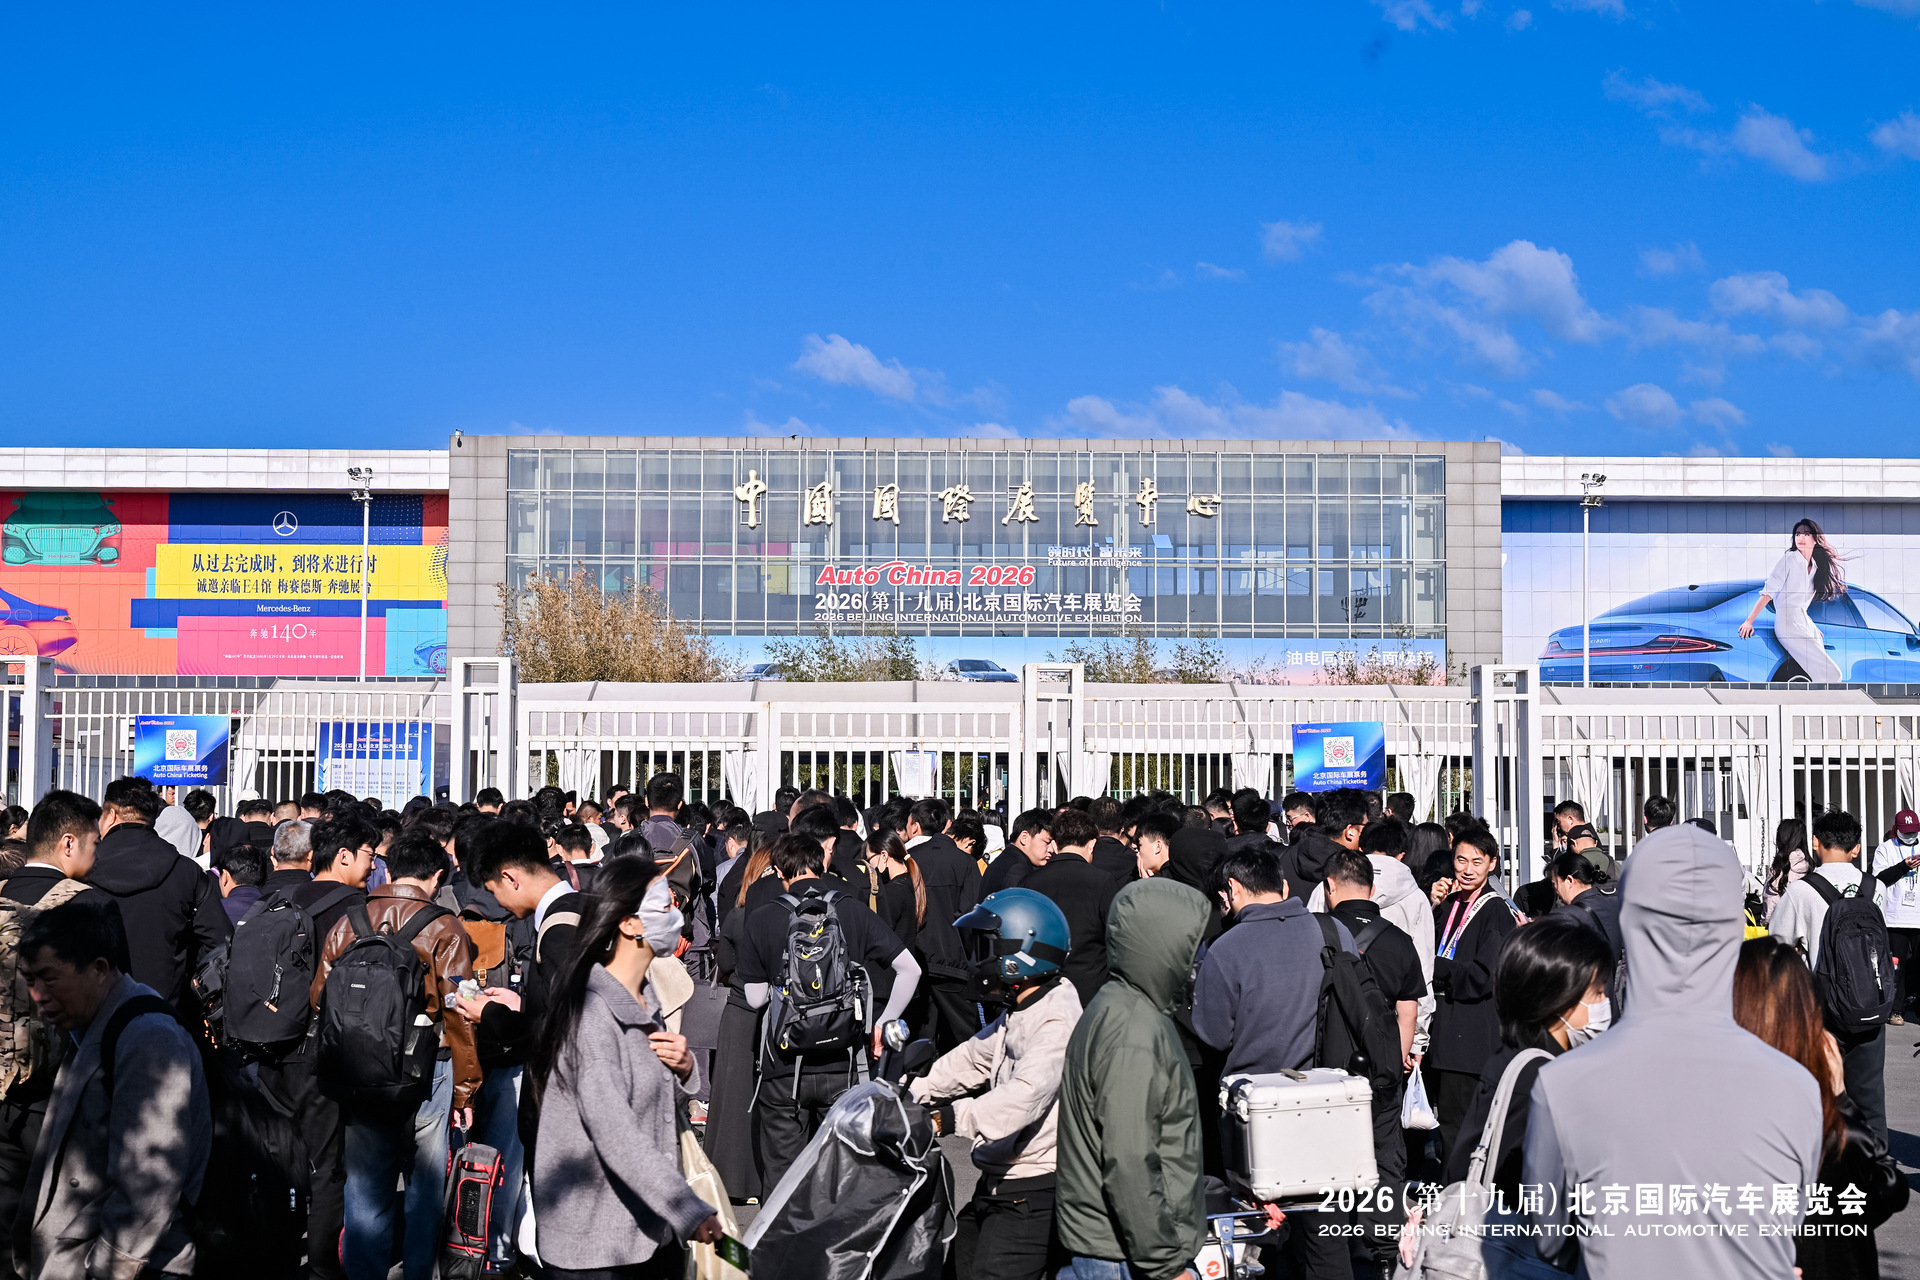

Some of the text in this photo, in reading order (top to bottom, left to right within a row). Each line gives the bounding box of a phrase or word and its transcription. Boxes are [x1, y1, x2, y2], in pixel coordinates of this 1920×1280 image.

[1048, 558, 1076, 567] Future
[1079, 558, 1090, 567] of
[815, 561, 1036, 587] Auto China 2026
[815, 591, 1143, 613] 2026(第十九届)北京国际汽车展览会
[257, 604, 311, 612] Mercedes-Benz
[814, 612, 1143, 623] 2026 BEIJING INTERNATIONAL AUTOMOTIVE EXHIBITION
[153, 764, 208, 772] 北京国际车展票务
[183, 772, 208, 780] Ticketing
[1313, 771, 1367, 779] 北京国际车展票务
